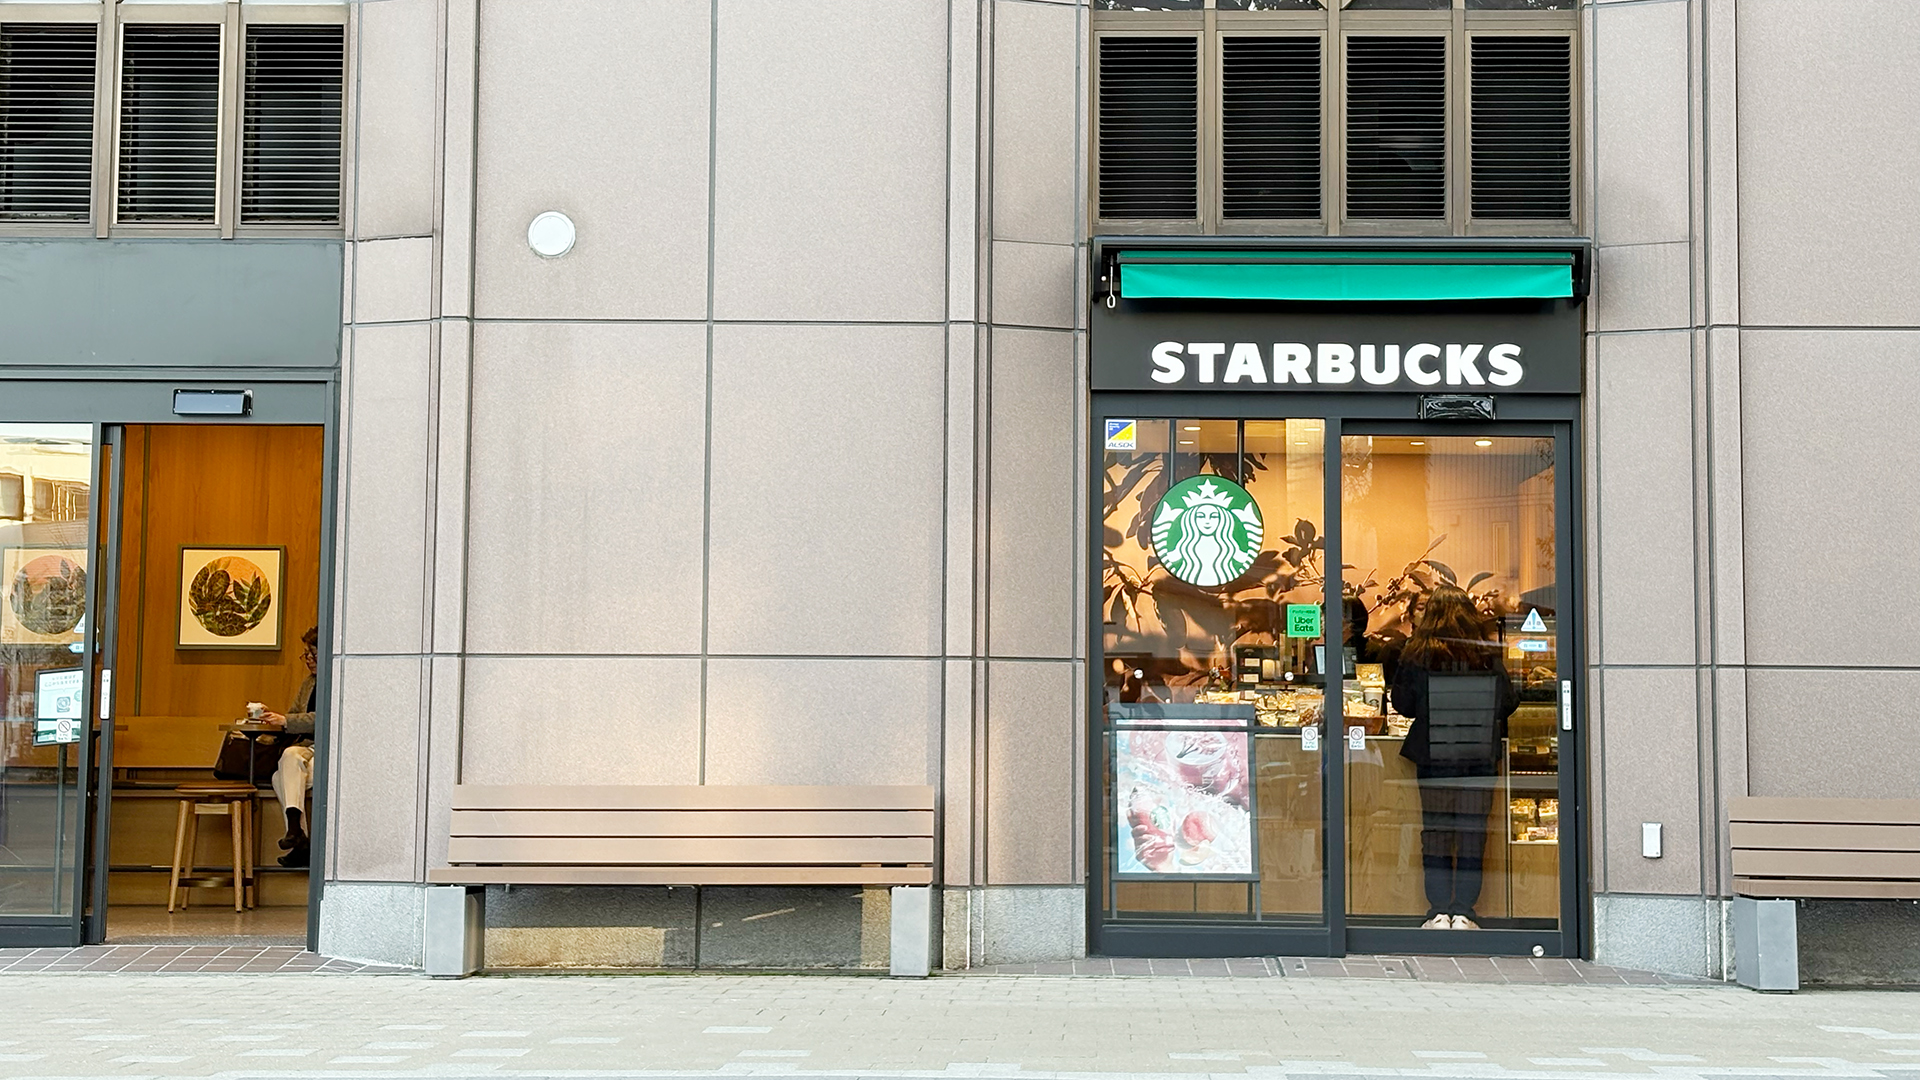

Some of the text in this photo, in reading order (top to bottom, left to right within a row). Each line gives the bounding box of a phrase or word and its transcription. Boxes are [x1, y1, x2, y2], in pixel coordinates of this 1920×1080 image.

[1150, 341, 1523, 386] STARBUCKS
[1294, 616, 1314, 624] Uber
[1294, 624, 1314, 632] Eats
